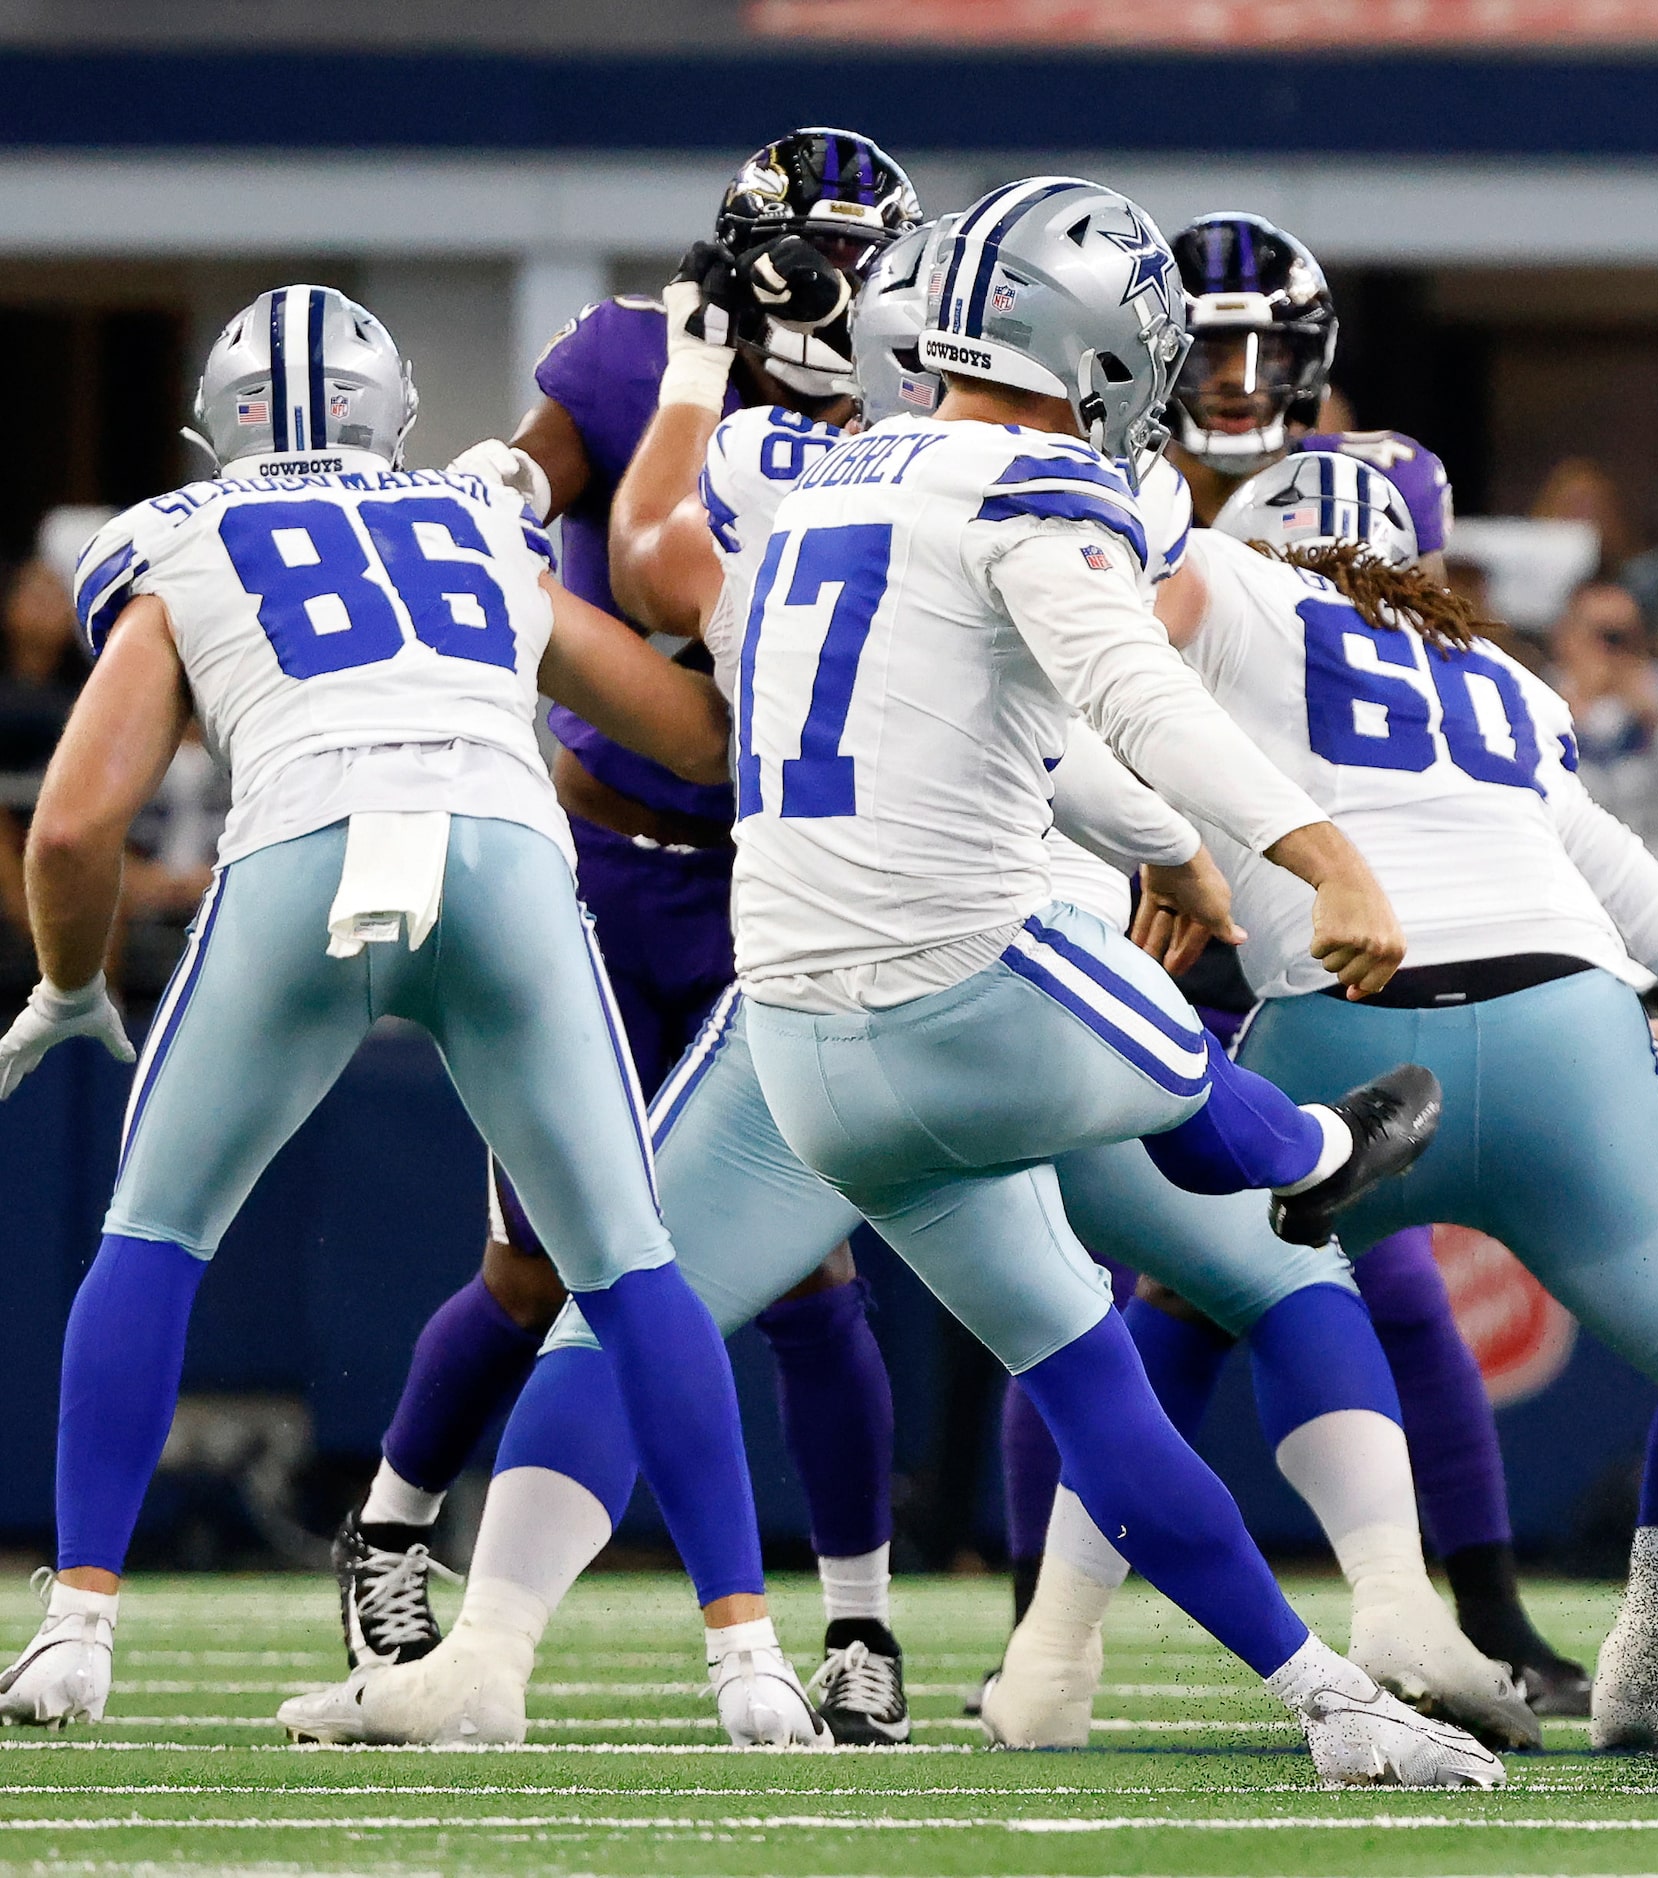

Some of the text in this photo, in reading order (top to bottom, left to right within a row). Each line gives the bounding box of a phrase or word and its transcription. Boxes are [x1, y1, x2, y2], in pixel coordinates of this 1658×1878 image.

[993, 294, 1013, 309] NFL
[926, 340, 992, 370] COWBOYS
[260, 458, 343, 477] COWBOYS
[218, 498, 518, 681] 86
[738, 523, 896, 823] 17
[1295, 598, 1548, 804] 60
